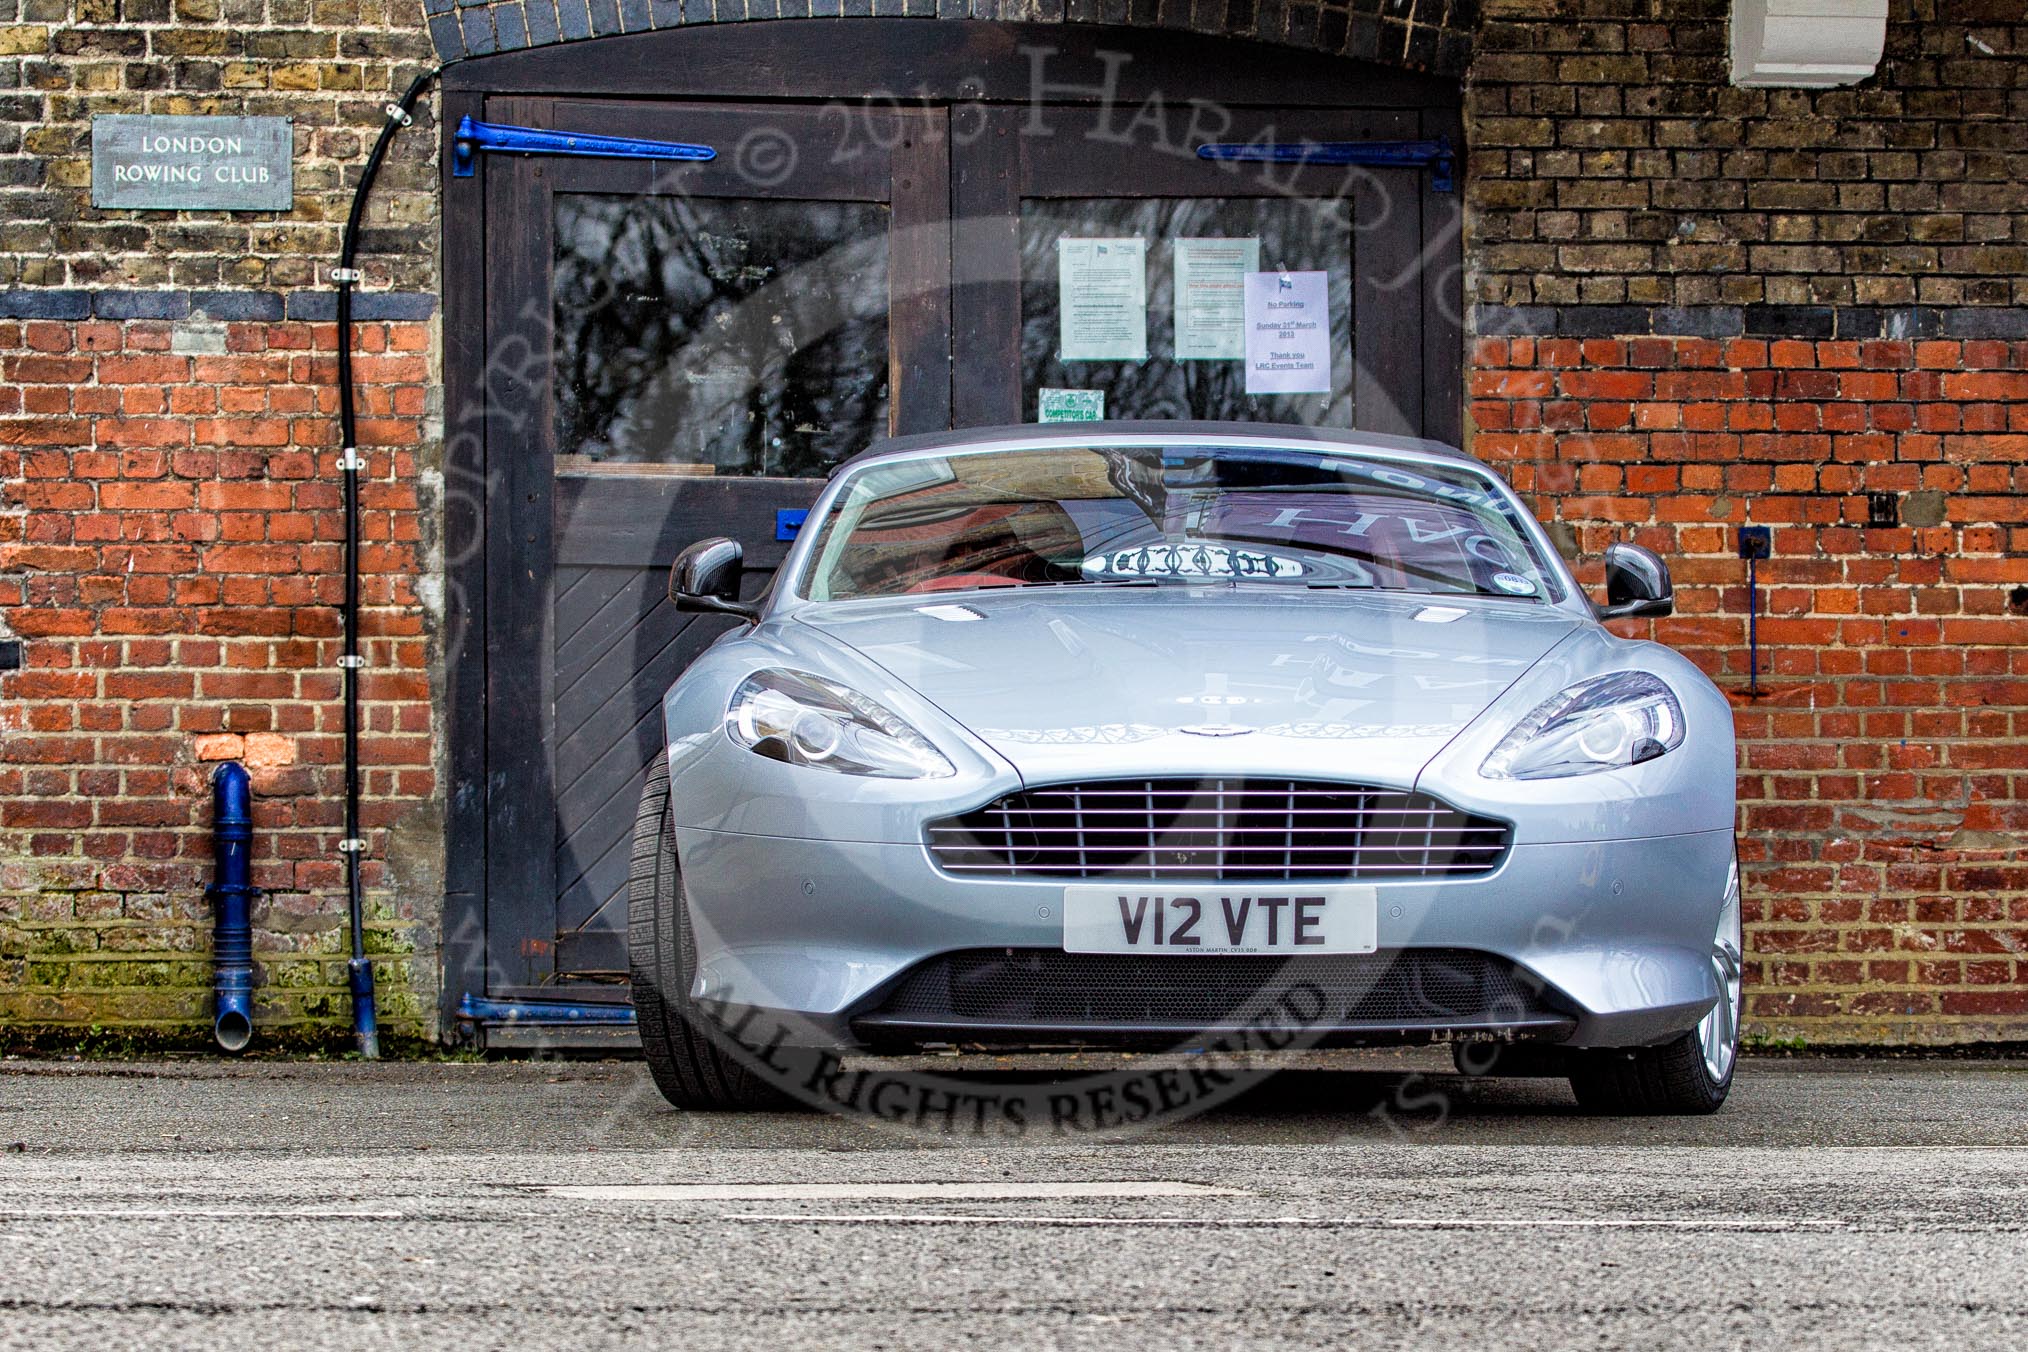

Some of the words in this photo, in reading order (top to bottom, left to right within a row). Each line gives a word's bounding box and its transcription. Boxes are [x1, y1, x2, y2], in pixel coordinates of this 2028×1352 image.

[142, 136, 242, 154] LONDON
[114, 164, 201, 183] ROWING
[215, 166, 270, 183] CLUB
[1267, 301, 1278, 309] No
[1279, 301, 1304, 309] Parking
[1256, 322, 1281, 330] Sunday
[1296, 321, 1317, 329] March
[1270, 352, 1291, 360] Thank
[1255, 362, 1270, 370] LRC
[1271, 362, 1294, 370] Events
[1296, 362, 1314, 370] Team
[1117, 896, 1201, 945] V12
[1220, 896, 1326, 946] VTE
